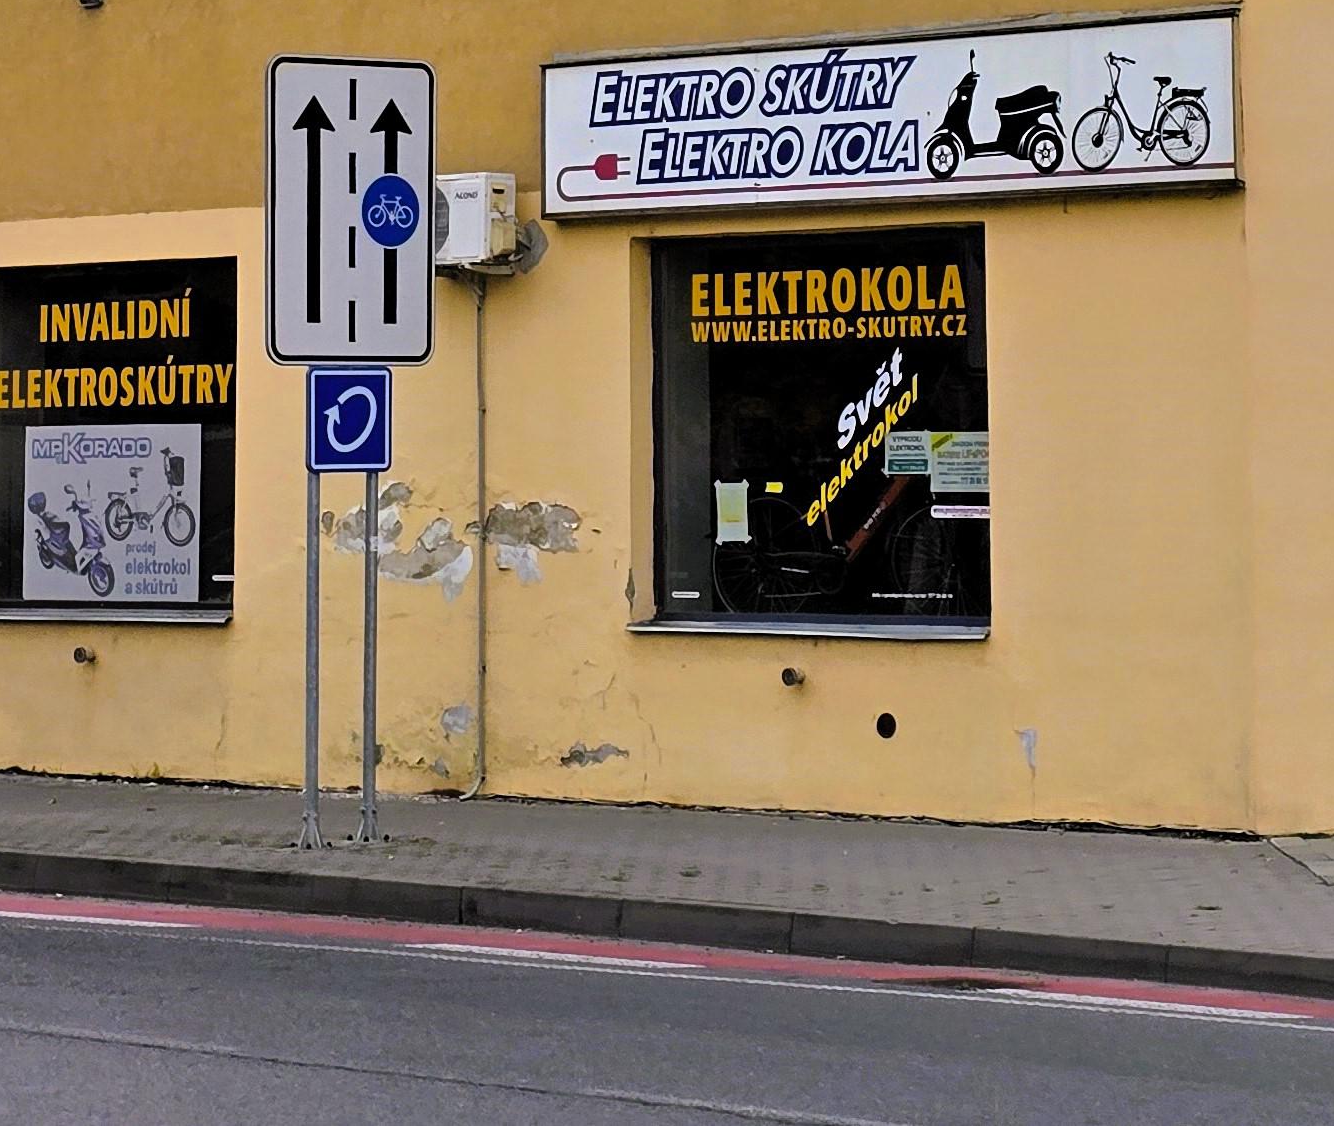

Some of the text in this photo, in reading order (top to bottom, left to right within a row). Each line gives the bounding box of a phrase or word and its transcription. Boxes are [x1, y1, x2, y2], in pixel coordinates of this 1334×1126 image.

[589, 49, 917, 127] ELEKTRO SKÚTRY
[636, 120, 919, 185] ELEKTRO KOLA
[39, 287, 192, 343] INVALIDNÍ
[691, 264, 966, 317] ELEKTROKOLA
[691, 314, 967, 343] WWW.ELEKTRO-SKUTRY.CZ
[837, 347, 903, 449] Svět
[807, 373, 918, 527] elektrokol
[125, 541, 156, 555] prodej
[125, 558, 192, 575] elektrokol
[125, 577, 178, 595] a skútrů
